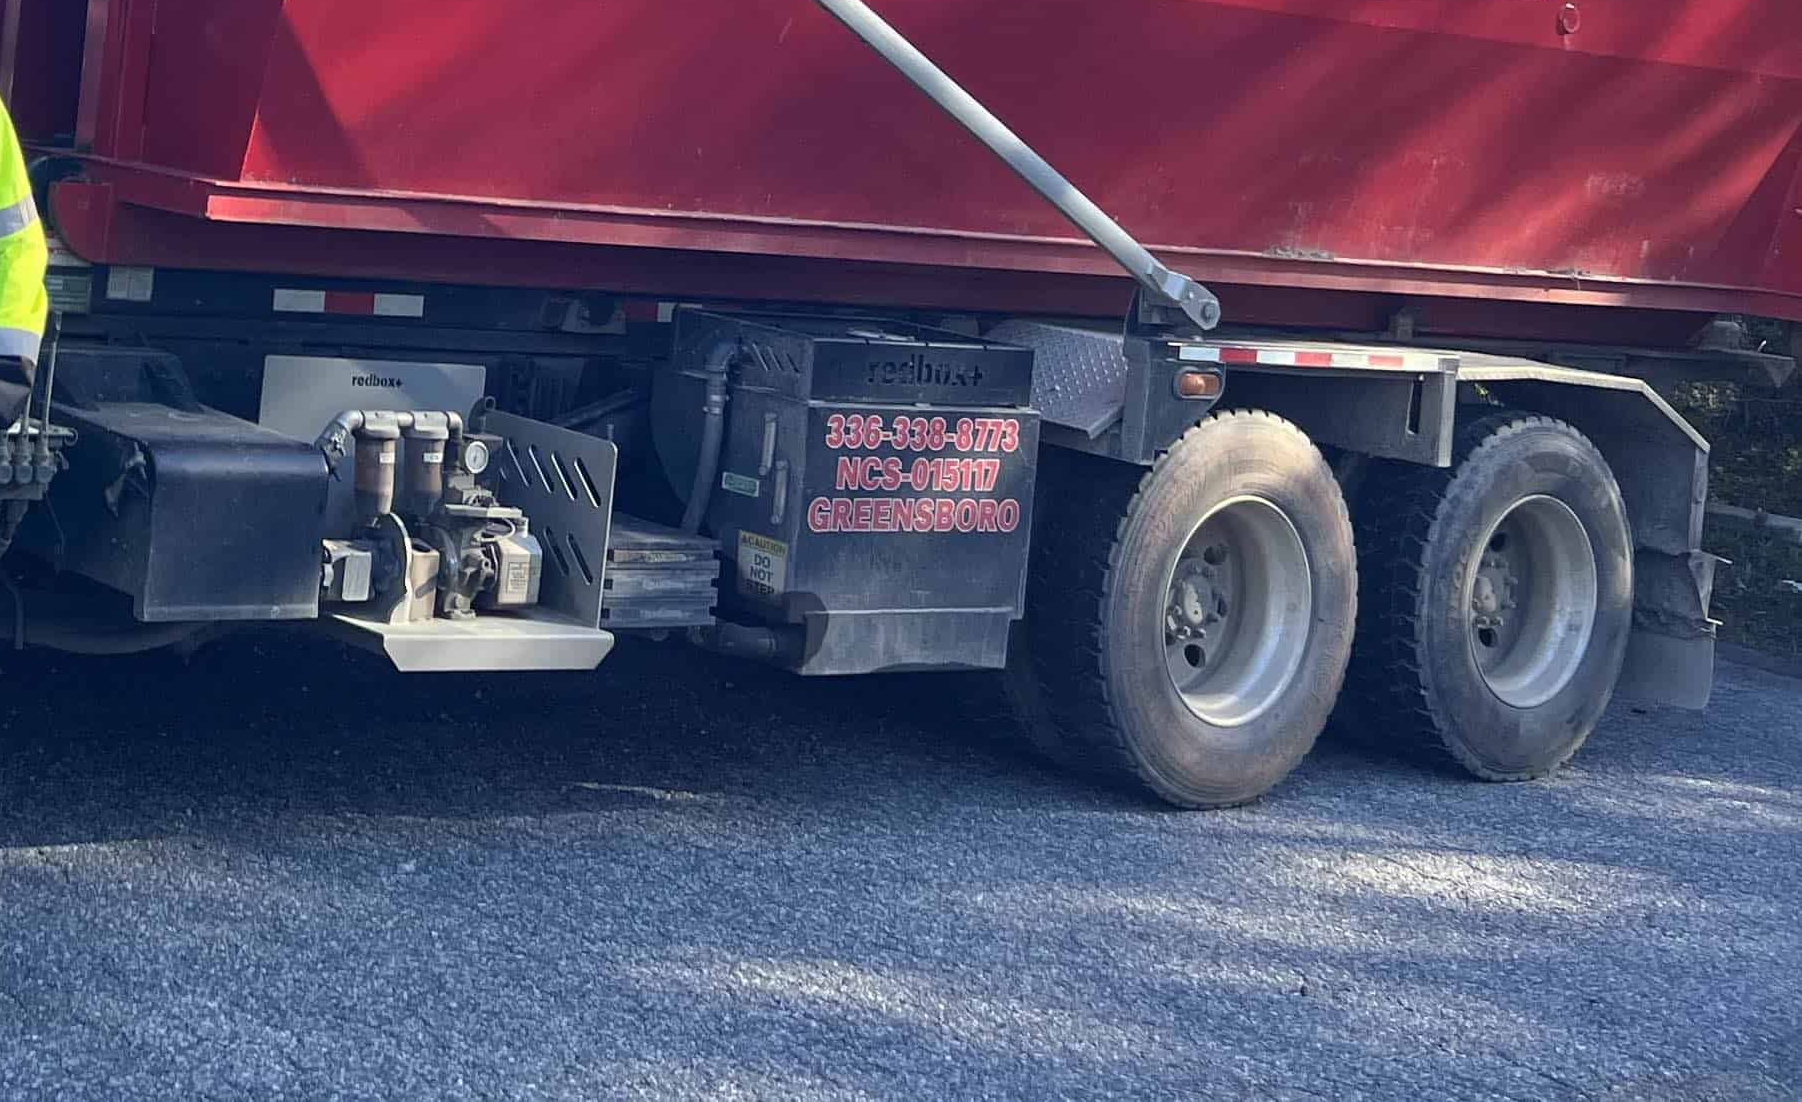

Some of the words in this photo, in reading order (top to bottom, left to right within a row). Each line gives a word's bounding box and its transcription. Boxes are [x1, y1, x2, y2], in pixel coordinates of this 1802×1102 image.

[826, 414, 1020, 452] 336-338-8773
[835, 456, 1000, 491] NCS-015117
[807, 497, 1020, 532] GREENSBORO
[746, 534, 786, 556] CAUTION
[749, 565, 775, 582] NOT
[754, 553, 771, 569] DO
